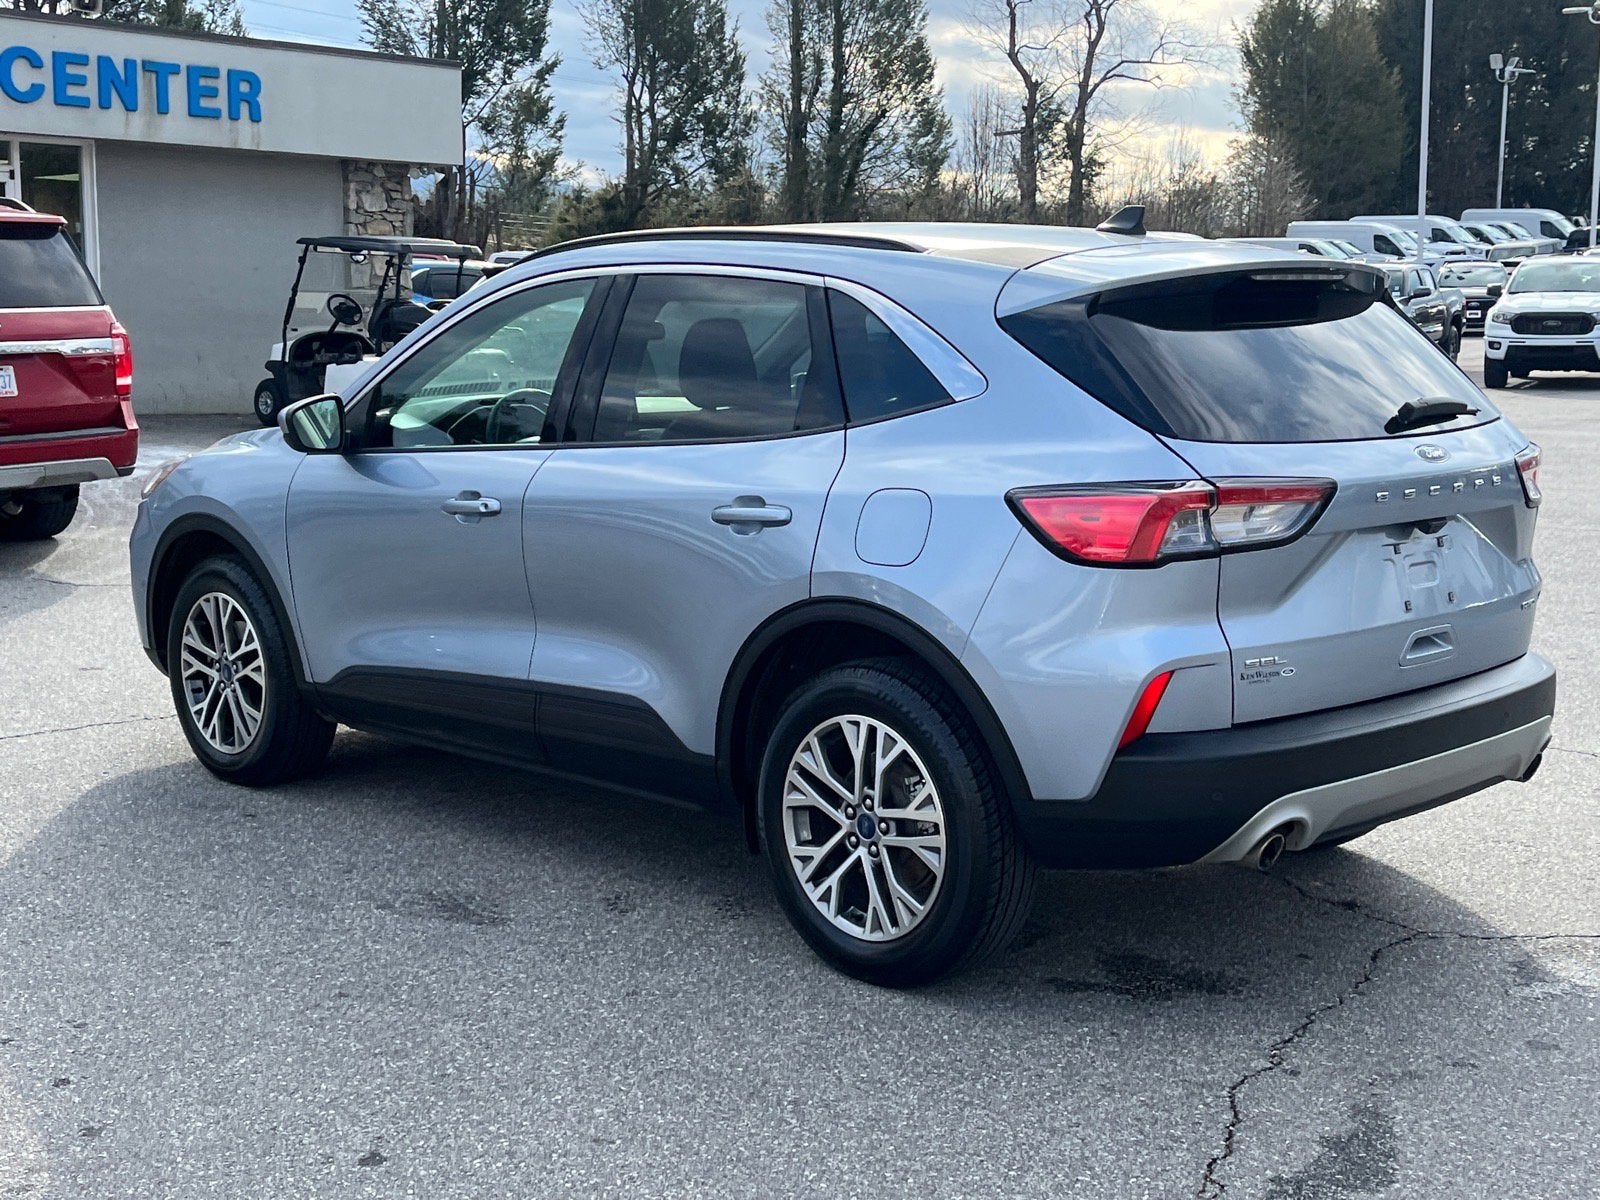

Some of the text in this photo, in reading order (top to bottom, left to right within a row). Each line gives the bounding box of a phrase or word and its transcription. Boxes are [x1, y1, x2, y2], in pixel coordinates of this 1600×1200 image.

[0, 45, 262, 123] CENTER
[1376, 475, 1502, 503] ESCAPE
[1245, 656, 1288, 669] SEL
